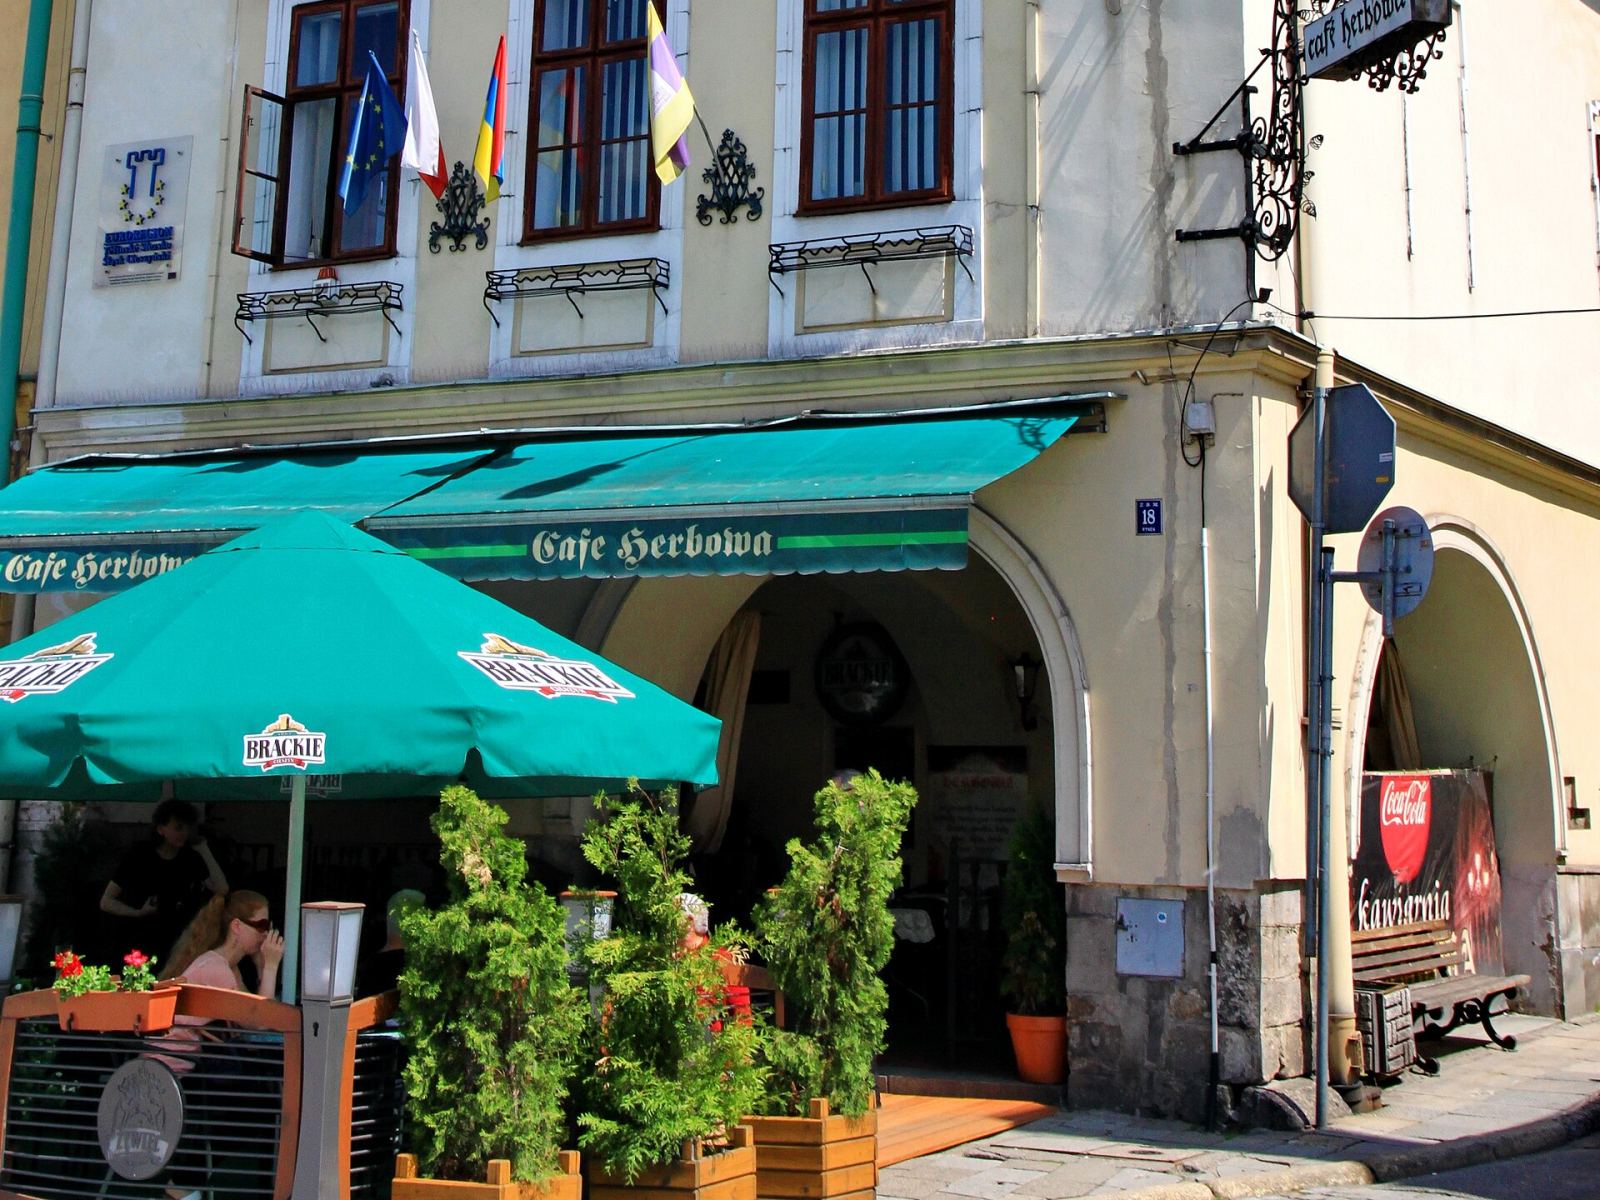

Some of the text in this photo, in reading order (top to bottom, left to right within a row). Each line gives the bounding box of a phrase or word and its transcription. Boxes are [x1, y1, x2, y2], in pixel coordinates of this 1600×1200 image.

[1308, 16, 1336, 61] café
[1142, 509, 1156, 525] 18
[532, 524, 773, 571] Cafe Herbowa
[5, 550, 194, 589] Cafe Herbow
[471, 659, 621, 690] BRACKIE
[247, 738, 323, 759] BRACKIE
[1358, 877, 1450, 932] kawiarnia
